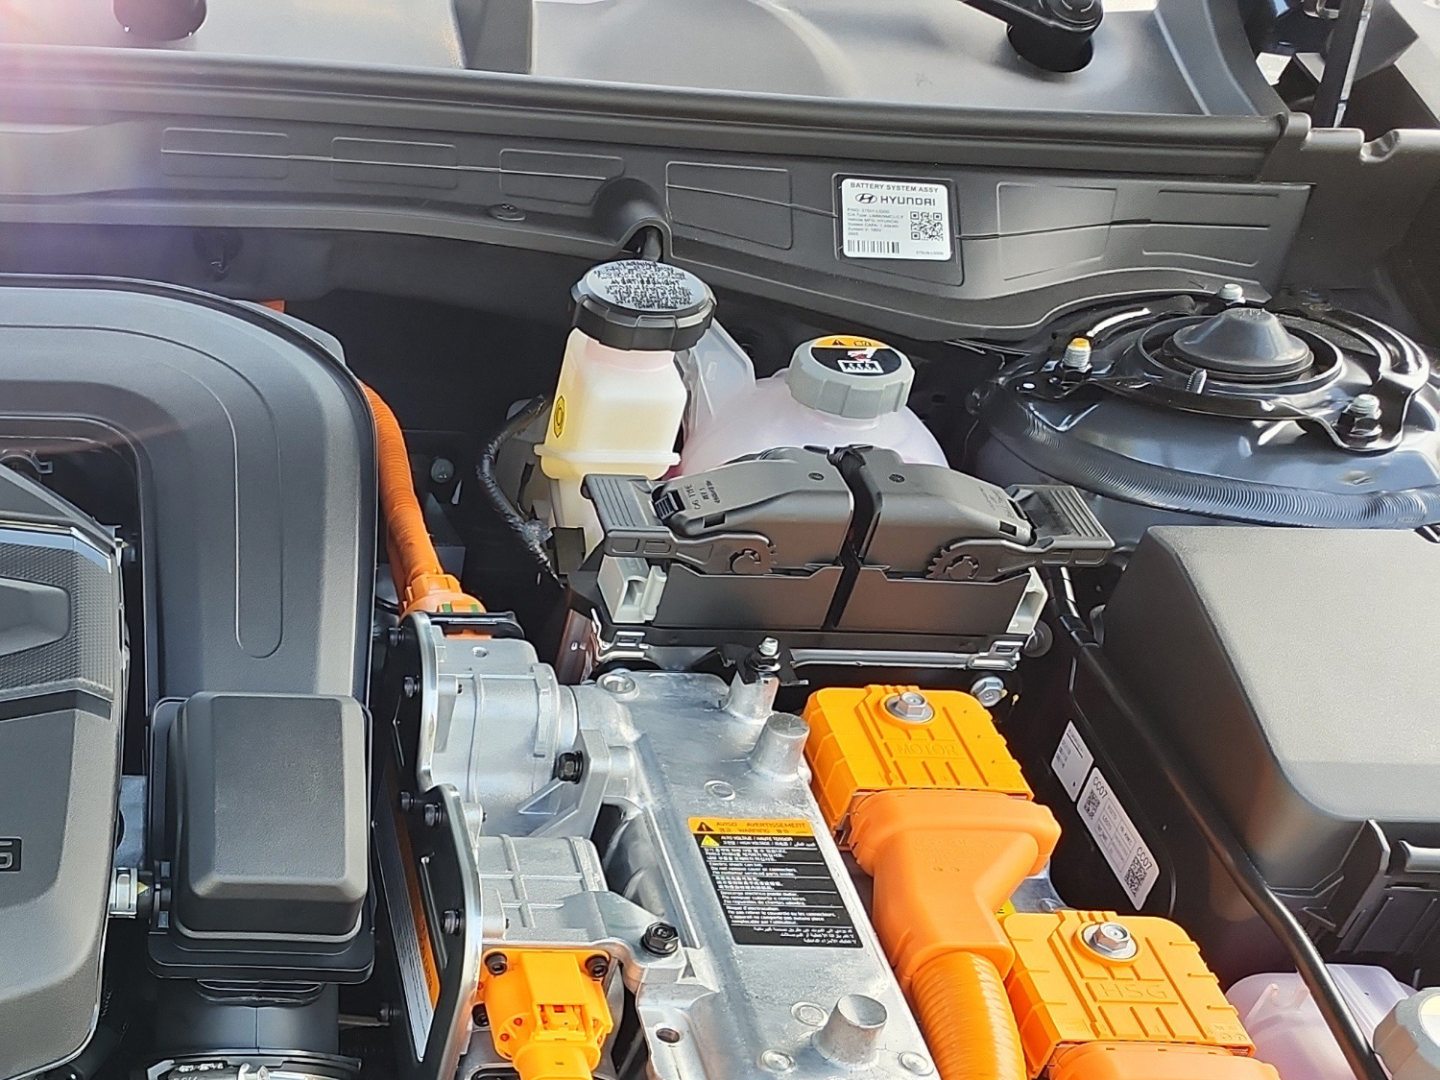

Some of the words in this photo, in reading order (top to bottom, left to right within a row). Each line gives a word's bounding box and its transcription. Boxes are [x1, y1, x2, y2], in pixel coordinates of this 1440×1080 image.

[880, 195, 936, 206] HYUNDAI
[896, 742, 959, 755] MOTOR
[1092, 776, 1108, 799] CC07
[1136, 846, 1153, 871] CC07
[1099, 983, 1168, 999] HSG
